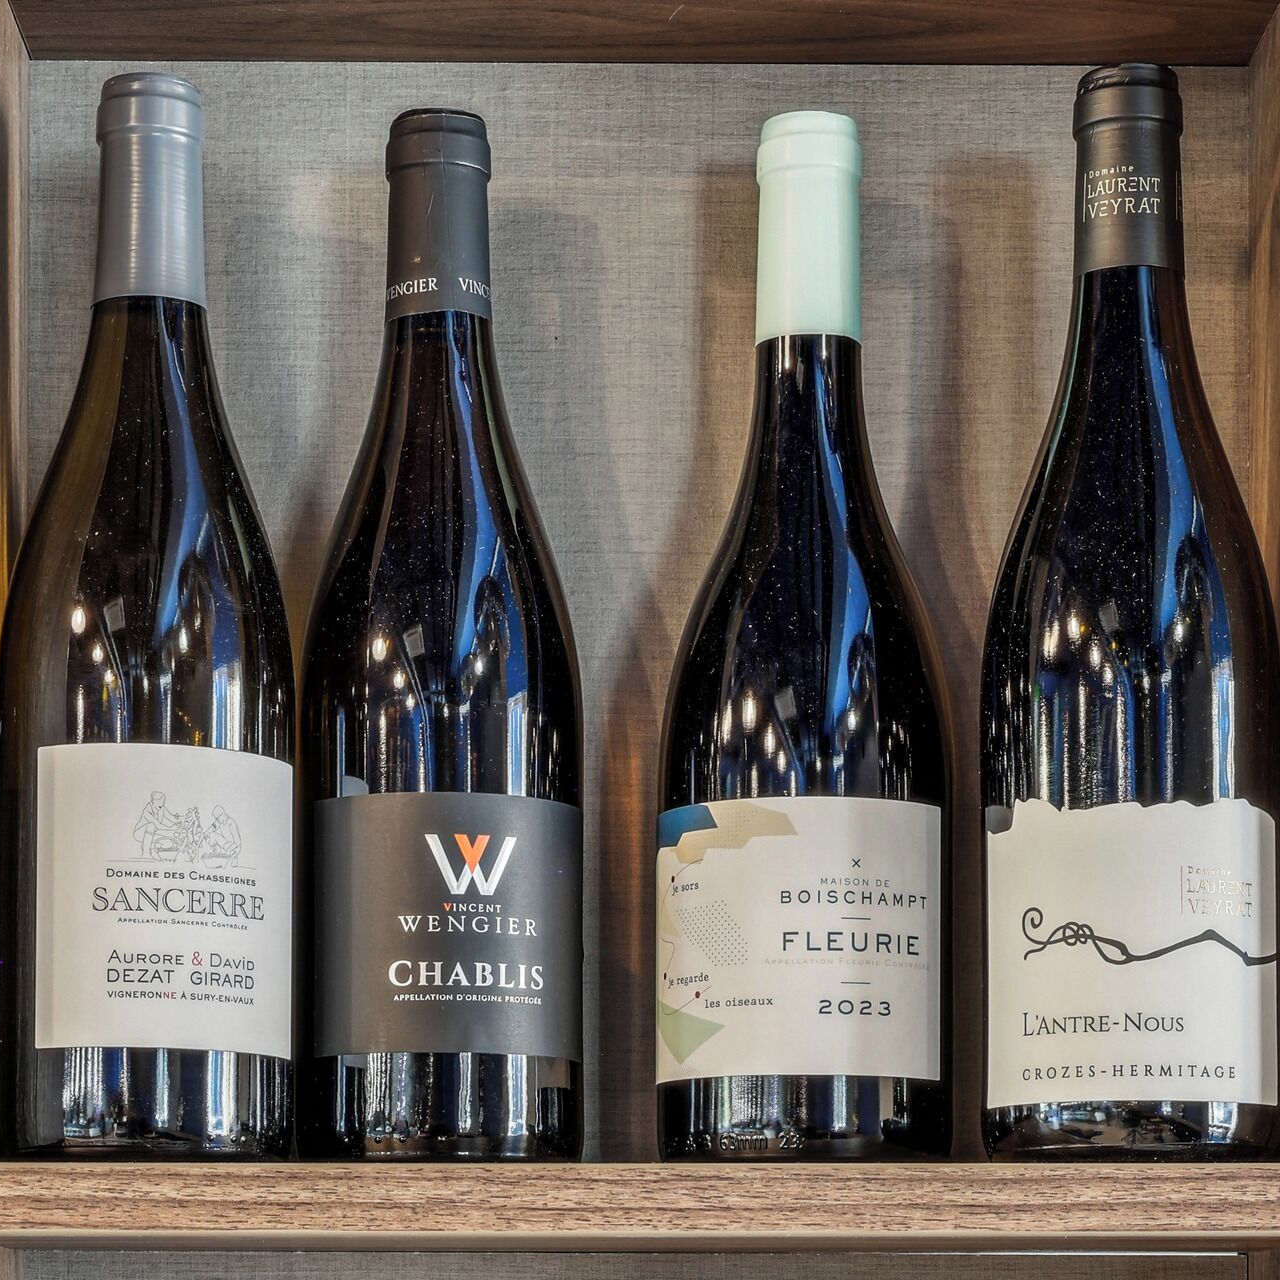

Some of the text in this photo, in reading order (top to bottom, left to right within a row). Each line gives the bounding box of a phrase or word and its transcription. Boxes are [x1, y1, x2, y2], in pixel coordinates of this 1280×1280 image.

[1088, 177, 1160, 198] LAURENT
[1088, 198, 1160, 219] VEYRAT
[682, 881, 699, 892] sors
[820, 877, 889, 888] MAISON DE
[92, 886, 265, 921] SANCERRE
[443, 902, 502, 913] VINCENT
[781, 890, 927, 910] BOISCHAMPT
[398, 916, 538, 936] WENGIER
[782, 931, 919, 956] FLEURIE
[191, 951, 203, 966] &
[107, 969, 254, 989] DEZAT GIRARD
[388, 960, 544, 990] CHABLIS
[677, 972, 709, 987] regarde
[107, 991, 254, 1005] VIGNERONNE À SURY-EN-VAUX
[394, 994, 453, 1002] APPELLATION
[457, 994, 502, 1002] D'ORIGINE
[705, 997, 773, 1009] les oiseaux
[819, 999, 891, 1016] 2023
